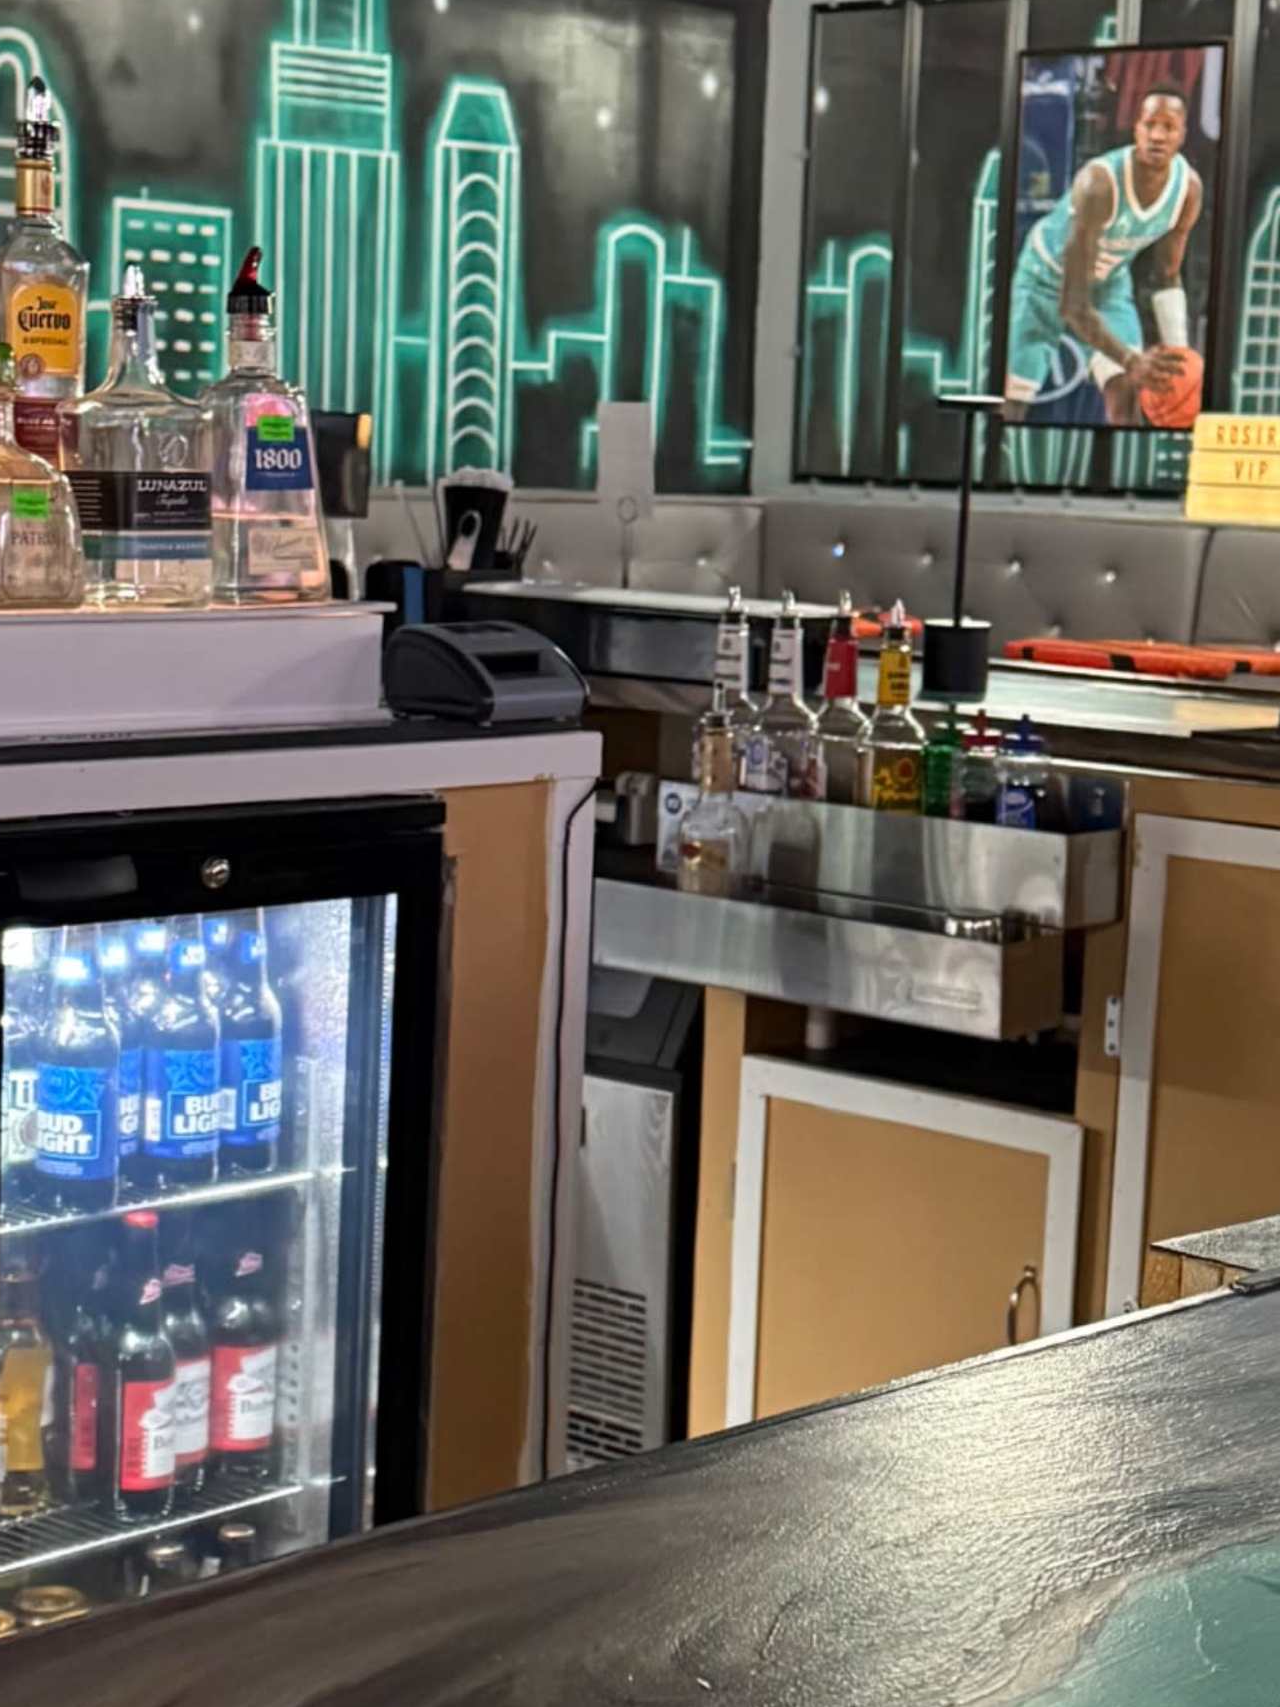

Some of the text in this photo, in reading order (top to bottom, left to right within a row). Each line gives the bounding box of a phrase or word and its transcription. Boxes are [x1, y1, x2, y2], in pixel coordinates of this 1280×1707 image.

[17, 306, 70, 332] Cuervo
[255, 447, 302, 470] 1800
[1234, 460, 1269, 481] VIP
[137, 479, 207, 492] LUNAZUL
[35, 1132, 93, 1155] IGHT
